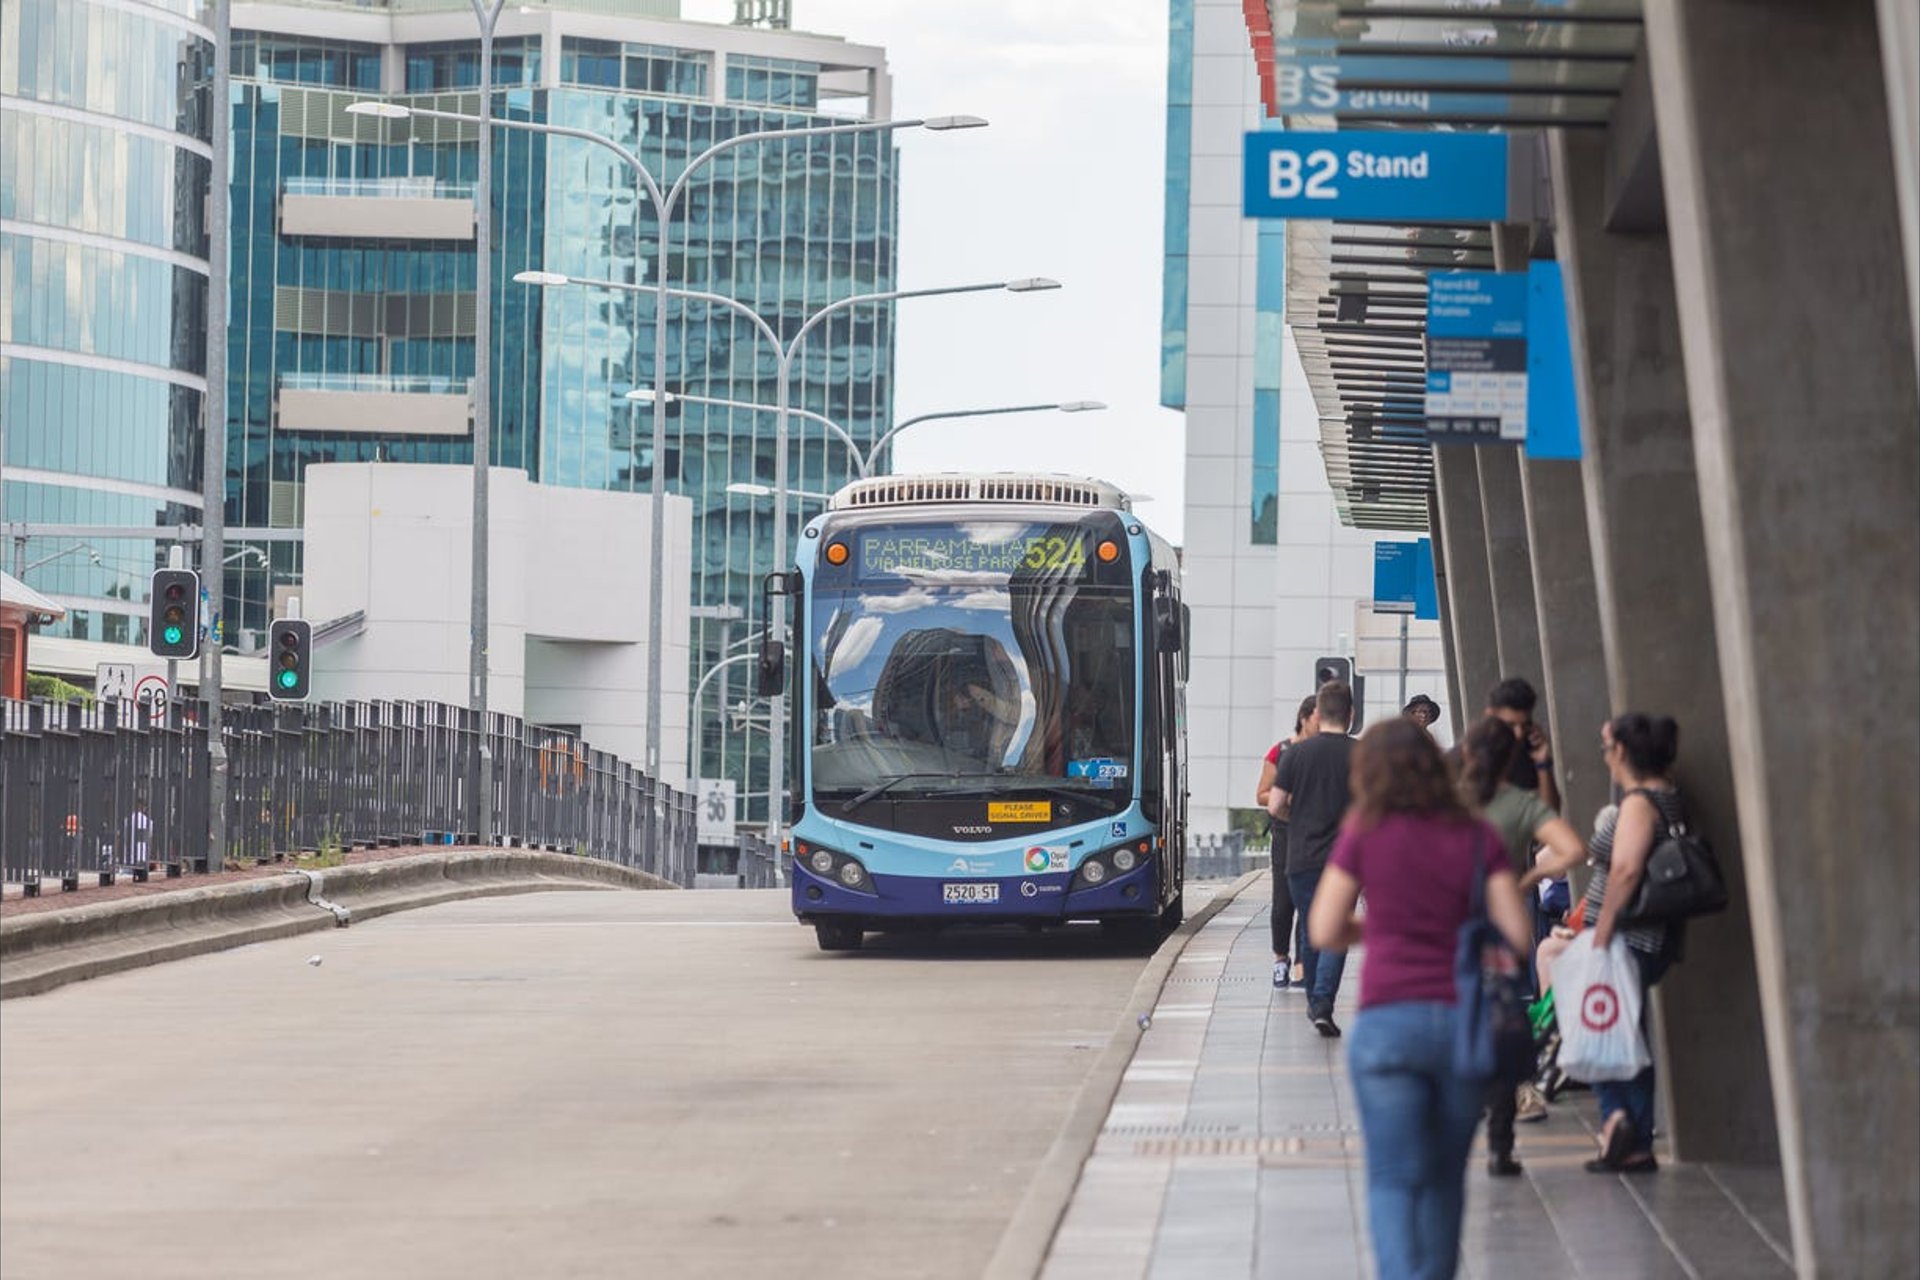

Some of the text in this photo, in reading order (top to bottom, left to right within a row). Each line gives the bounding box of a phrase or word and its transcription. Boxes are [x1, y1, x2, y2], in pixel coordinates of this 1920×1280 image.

[1268, 149, 1429, 199] B2 Stand
[1026, 536, 1087, 569] 524
[865, 556, 894, 570] VIA
[978, 556, 1024, 569] PARK
[952, 825, 993, 834] VOLVO
[1050, 860, 1065, 868] bus
